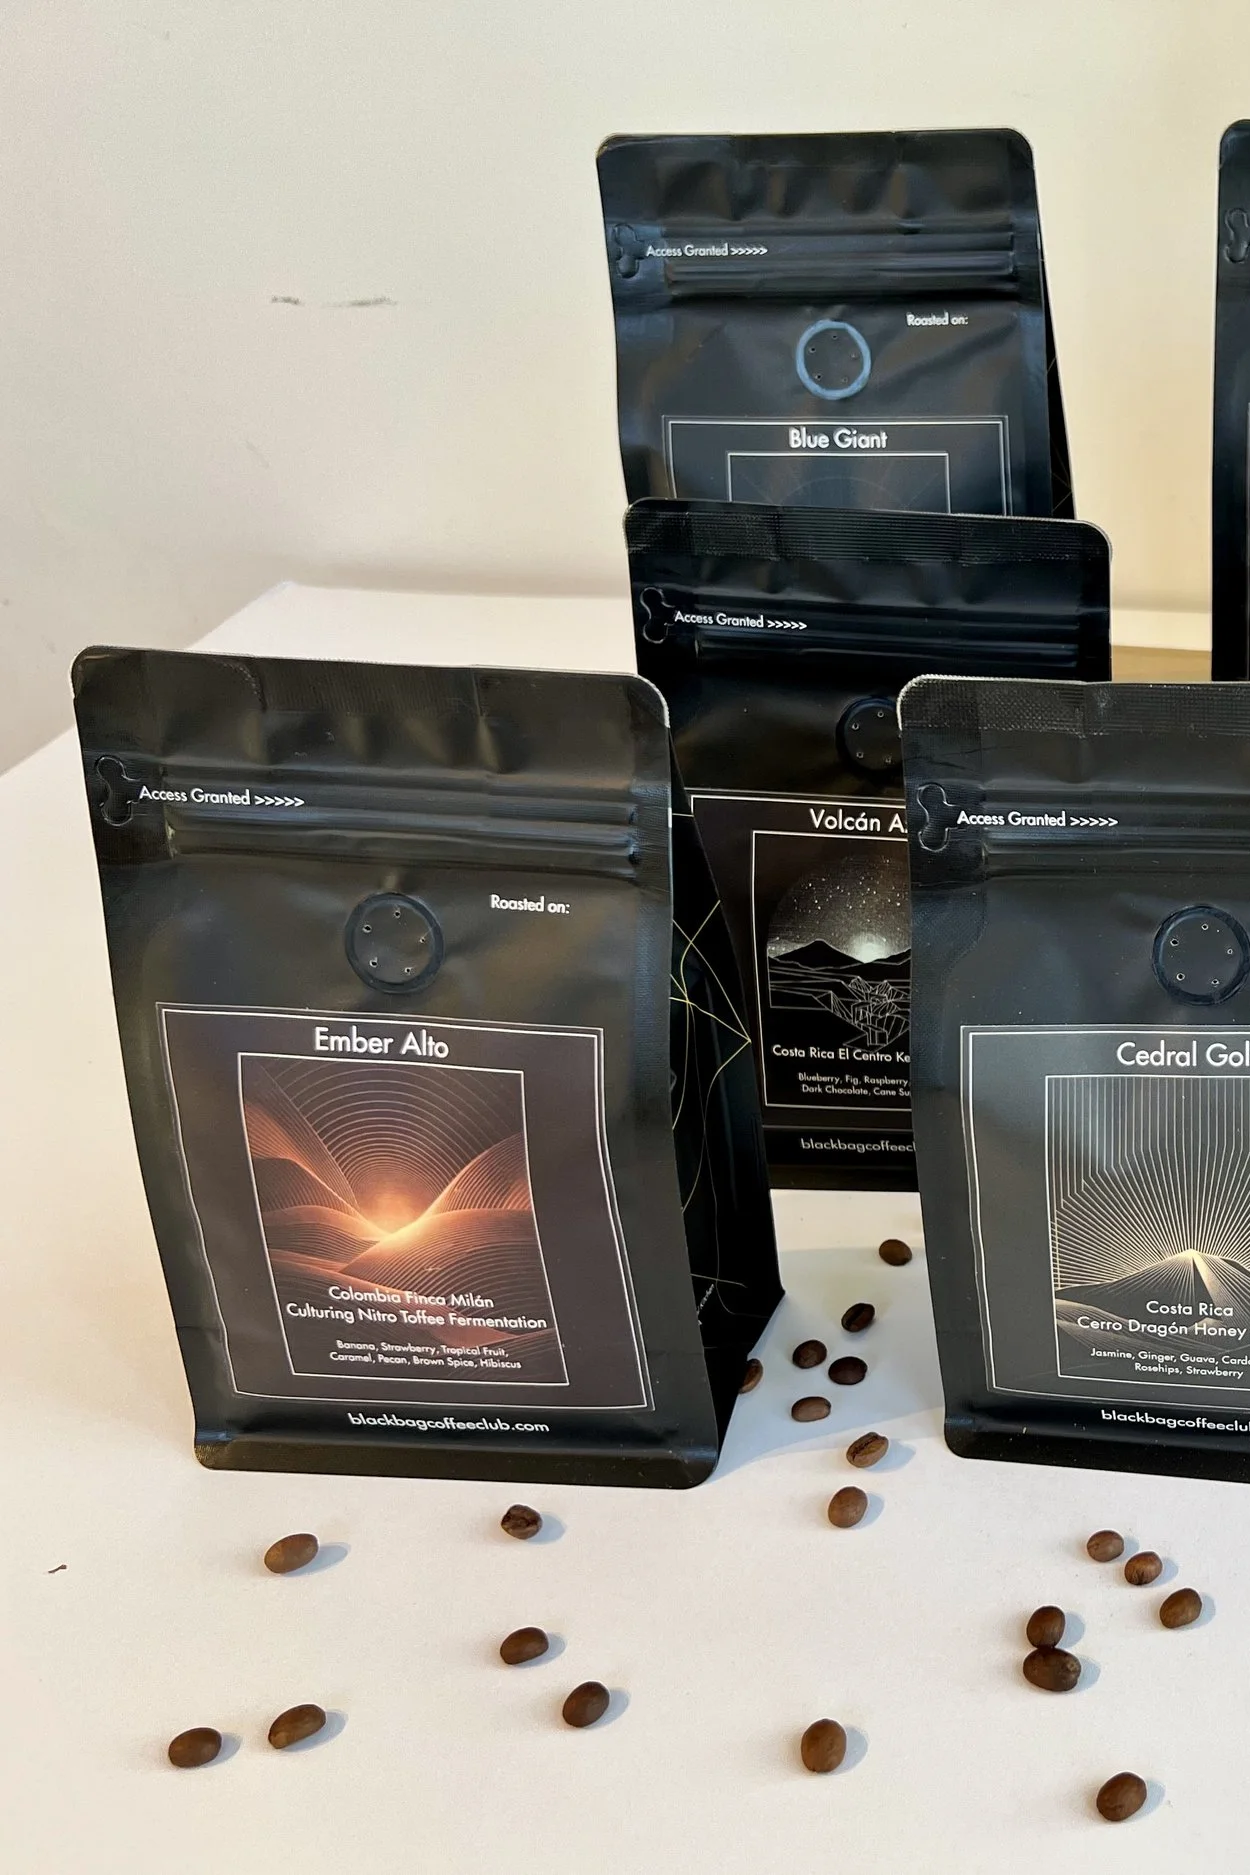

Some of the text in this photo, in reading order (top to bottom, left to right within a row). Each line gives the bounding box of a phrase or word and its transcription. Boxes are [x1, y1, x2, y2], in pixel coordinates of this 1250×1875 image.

[646, 244, 681, 258] Access
[684, 243, 728, 258] Granted
[907, 313, 969, 327] Roasted on:
[789, 428, 887, 449] Blue Giant
[675, 610, 713, 627] Access
[716, 613, 764, 628] Granted
[139, 785, 188, 803] Access
[190, 788, 250, 806] Granted
[810, 808, 907, 832] Volcán A
[957, 811, 1005, 826] Access
[1007, 811, 1066, 827] Granted
[491, 893, 570, 914] Roasted on:
[314, 1026, 449, 1059] Ember Alto
[772, 1044, 911, 1063] Costa Rica El Centro Ke
[1117, 1041, 1198, 1067] Cedral
[798, 1072, 842, 1084] Blueberry,
[845, 1075, 861, 1085] Fig,
[802, 1085, 911, 1097] Dark Chocolate, Cane Su
[801, 1138, 916, 1153] blackbagcoffeecl
[328, 1286, 494, 1308] Colombia Finca Milán
[286, 1303, 547, 1329] Culturing Nitro Toffee Fermentation
[1146, 1301, 1234, 1317] Costa Rica
[1077, 1316, 1123, 1331] Cerro
[1128, 1318, 1188, 1338] Dragón
[1194, 1323, 1246, 1340] Honey
[336, 1340, 509, 1358] Banana, Strawberry, Tropical Fruit,
[1090, 1348, 1135, 1361] Jasmine,
[1138, 1350, 1177, 1364] Ginger,
[1179, 1353, 1219, 1365] Guava,
[329, 1352, 522, 1369] Caramel, Pecan, Brown Spice, Hibiscus
[1134, 1363, 1244, 1380] Rosehips, Strawberry
[348, 1412, 550, 1433] blackbagcoffeeclub.com
